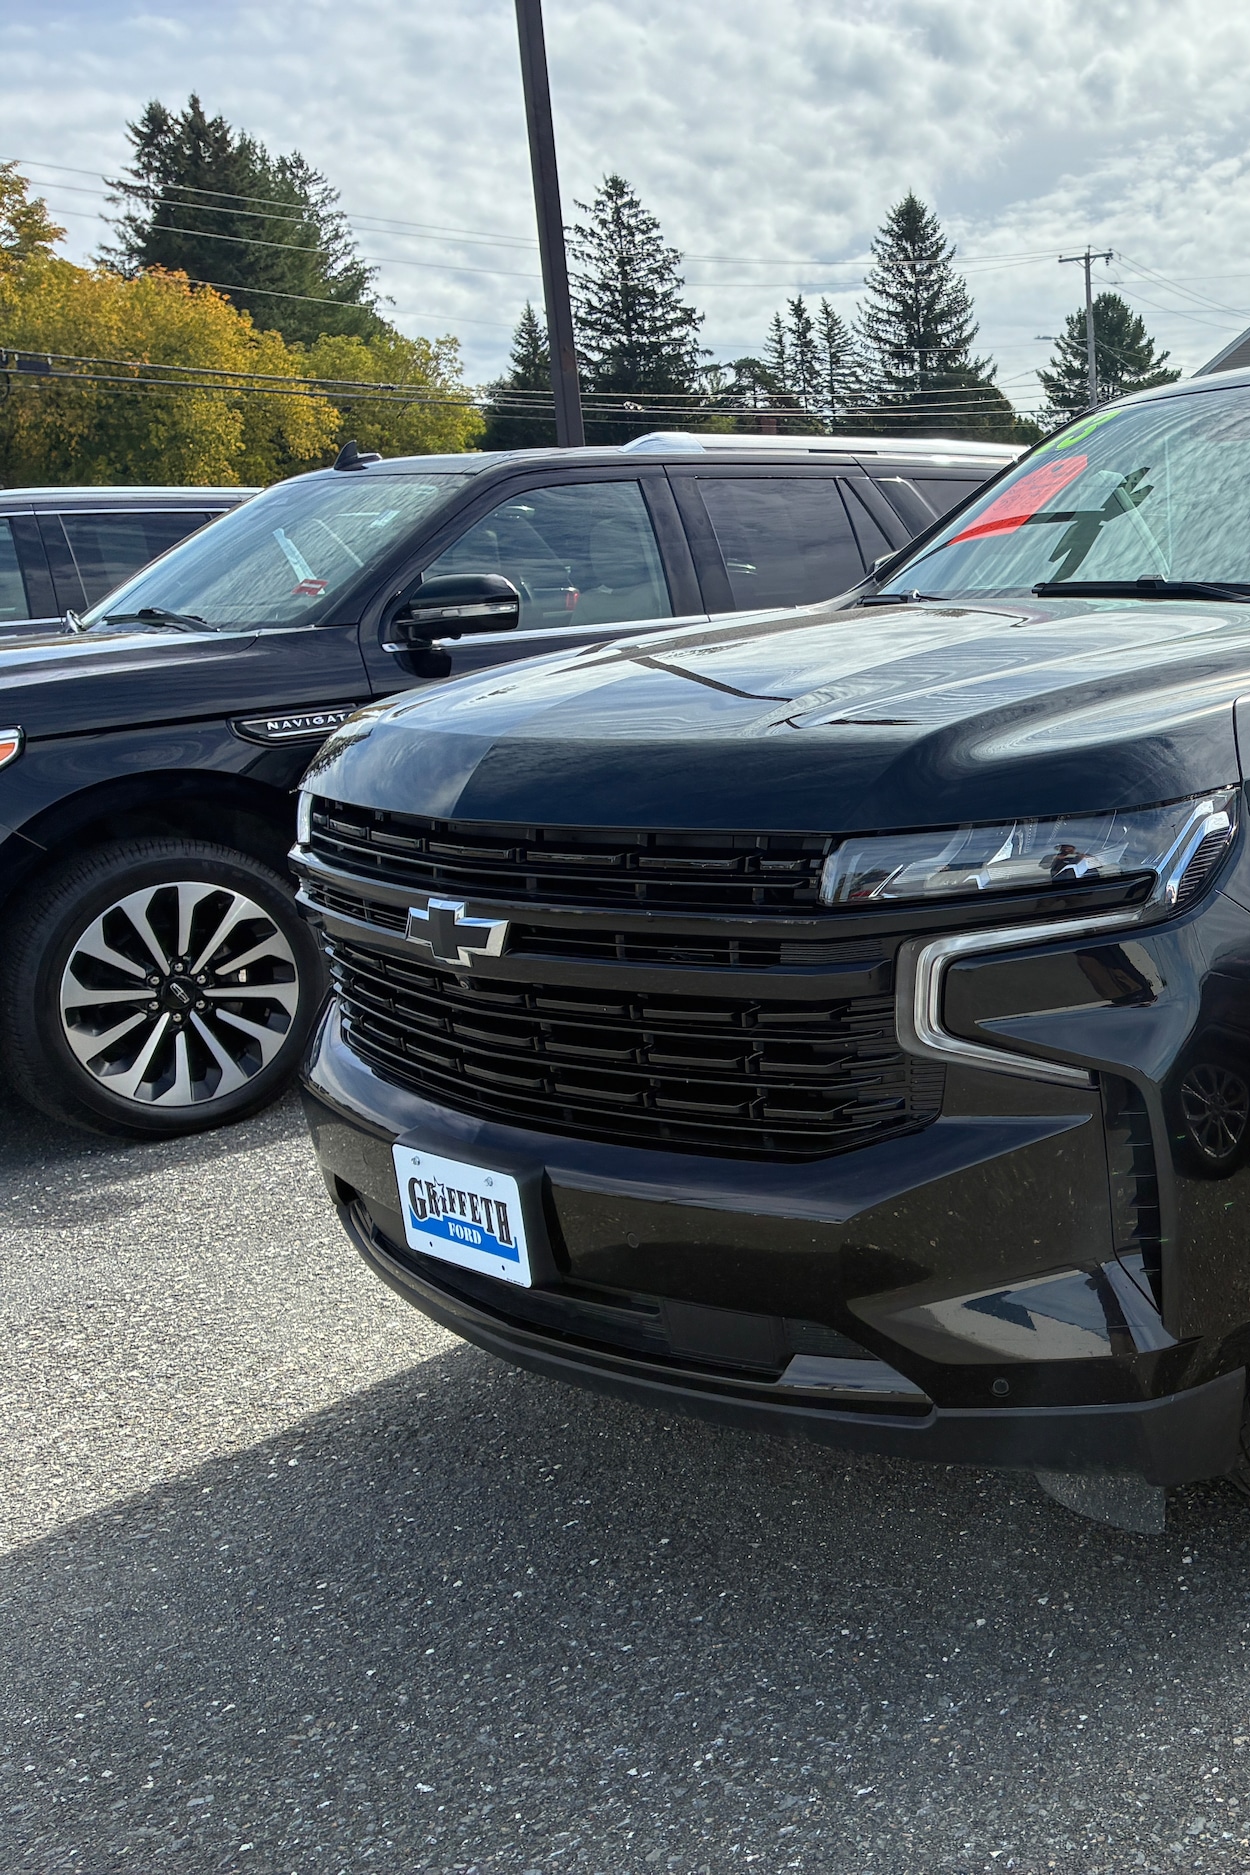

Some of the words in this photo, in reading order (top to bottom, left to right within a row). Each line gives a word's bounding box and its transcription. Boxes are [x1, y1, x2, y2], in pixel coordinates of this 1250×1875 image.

[266, 713, 352, 731] NAVIGAT
[408, 1176, 514, 1246] GRIFFETH
[447, 1221, 482, 1245] FORD
